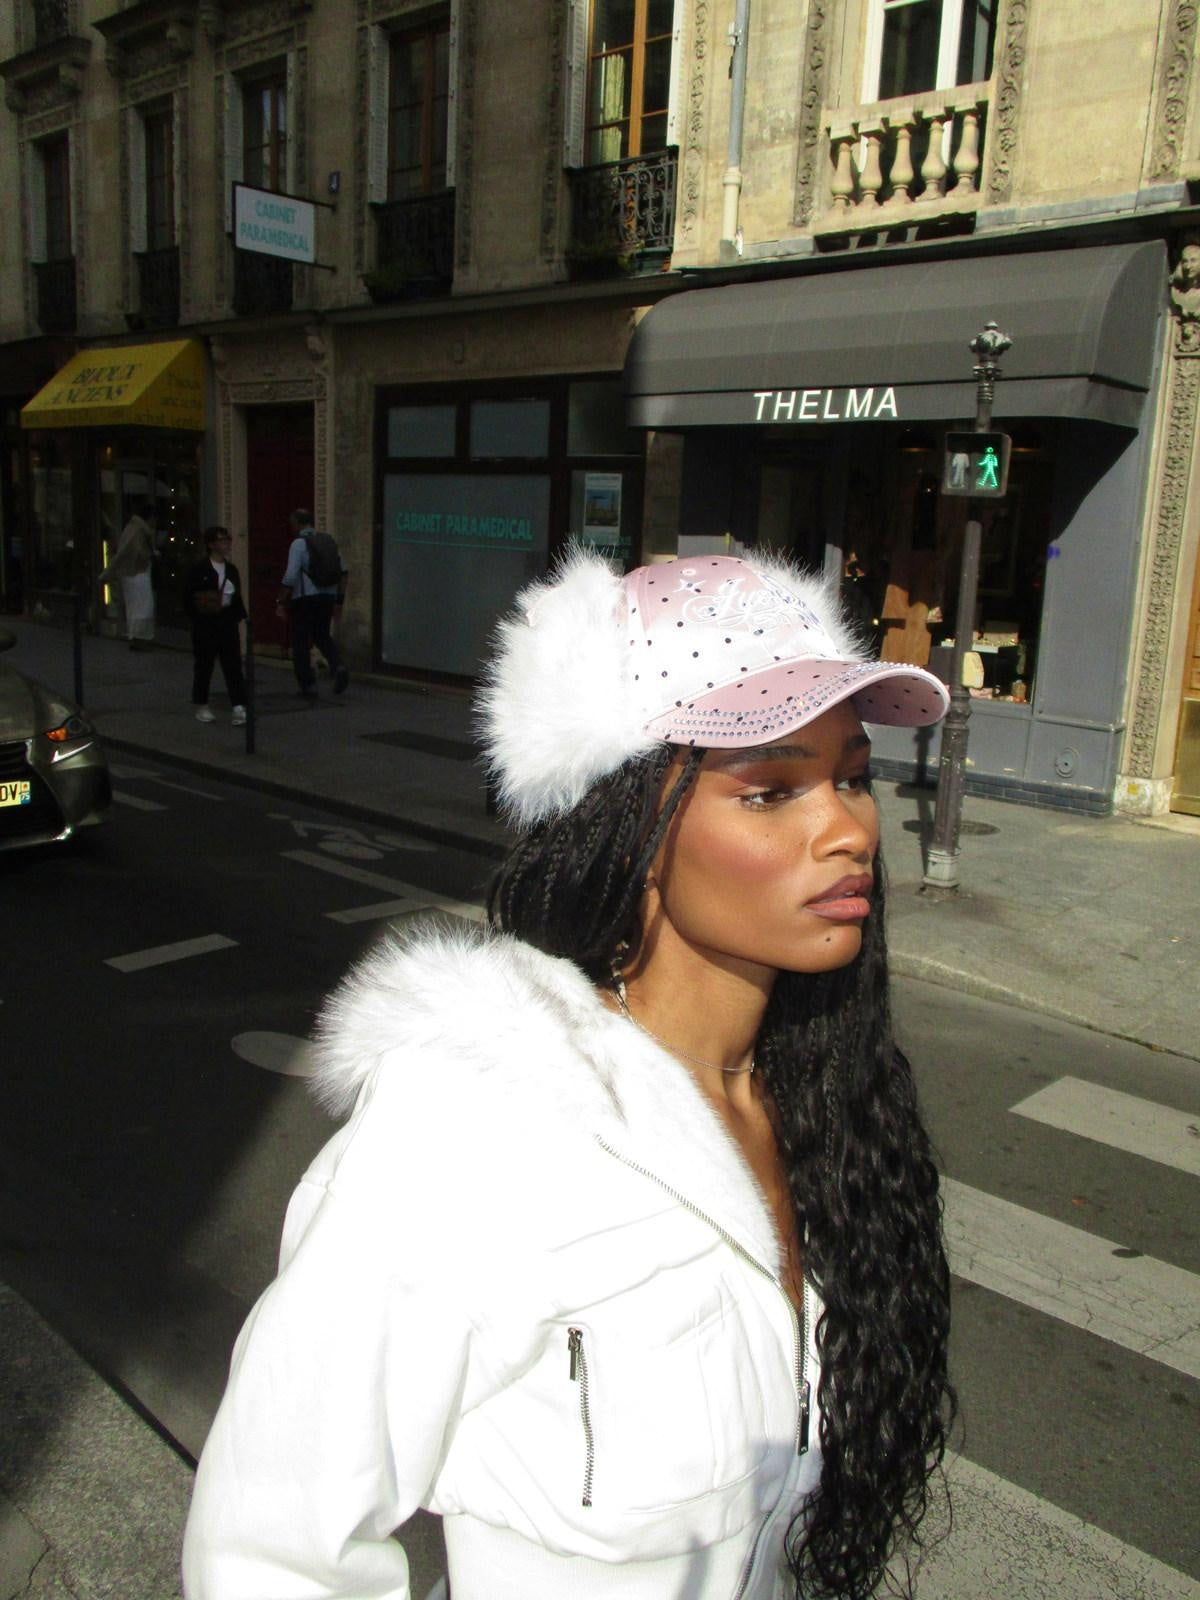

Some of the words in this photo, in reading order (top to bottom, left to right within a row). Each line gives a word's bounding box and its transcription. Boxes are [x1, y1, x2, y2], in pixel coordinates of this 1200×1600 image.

[255, 200, 296, 225] CABINET
[240, 221, 309, 252] PARAMEDICAL
[753, 387, 898, 421] THELMA
[396, 512, 441, 532] CABINET
[446, 515, 534, 540] PARAMEDICAL
